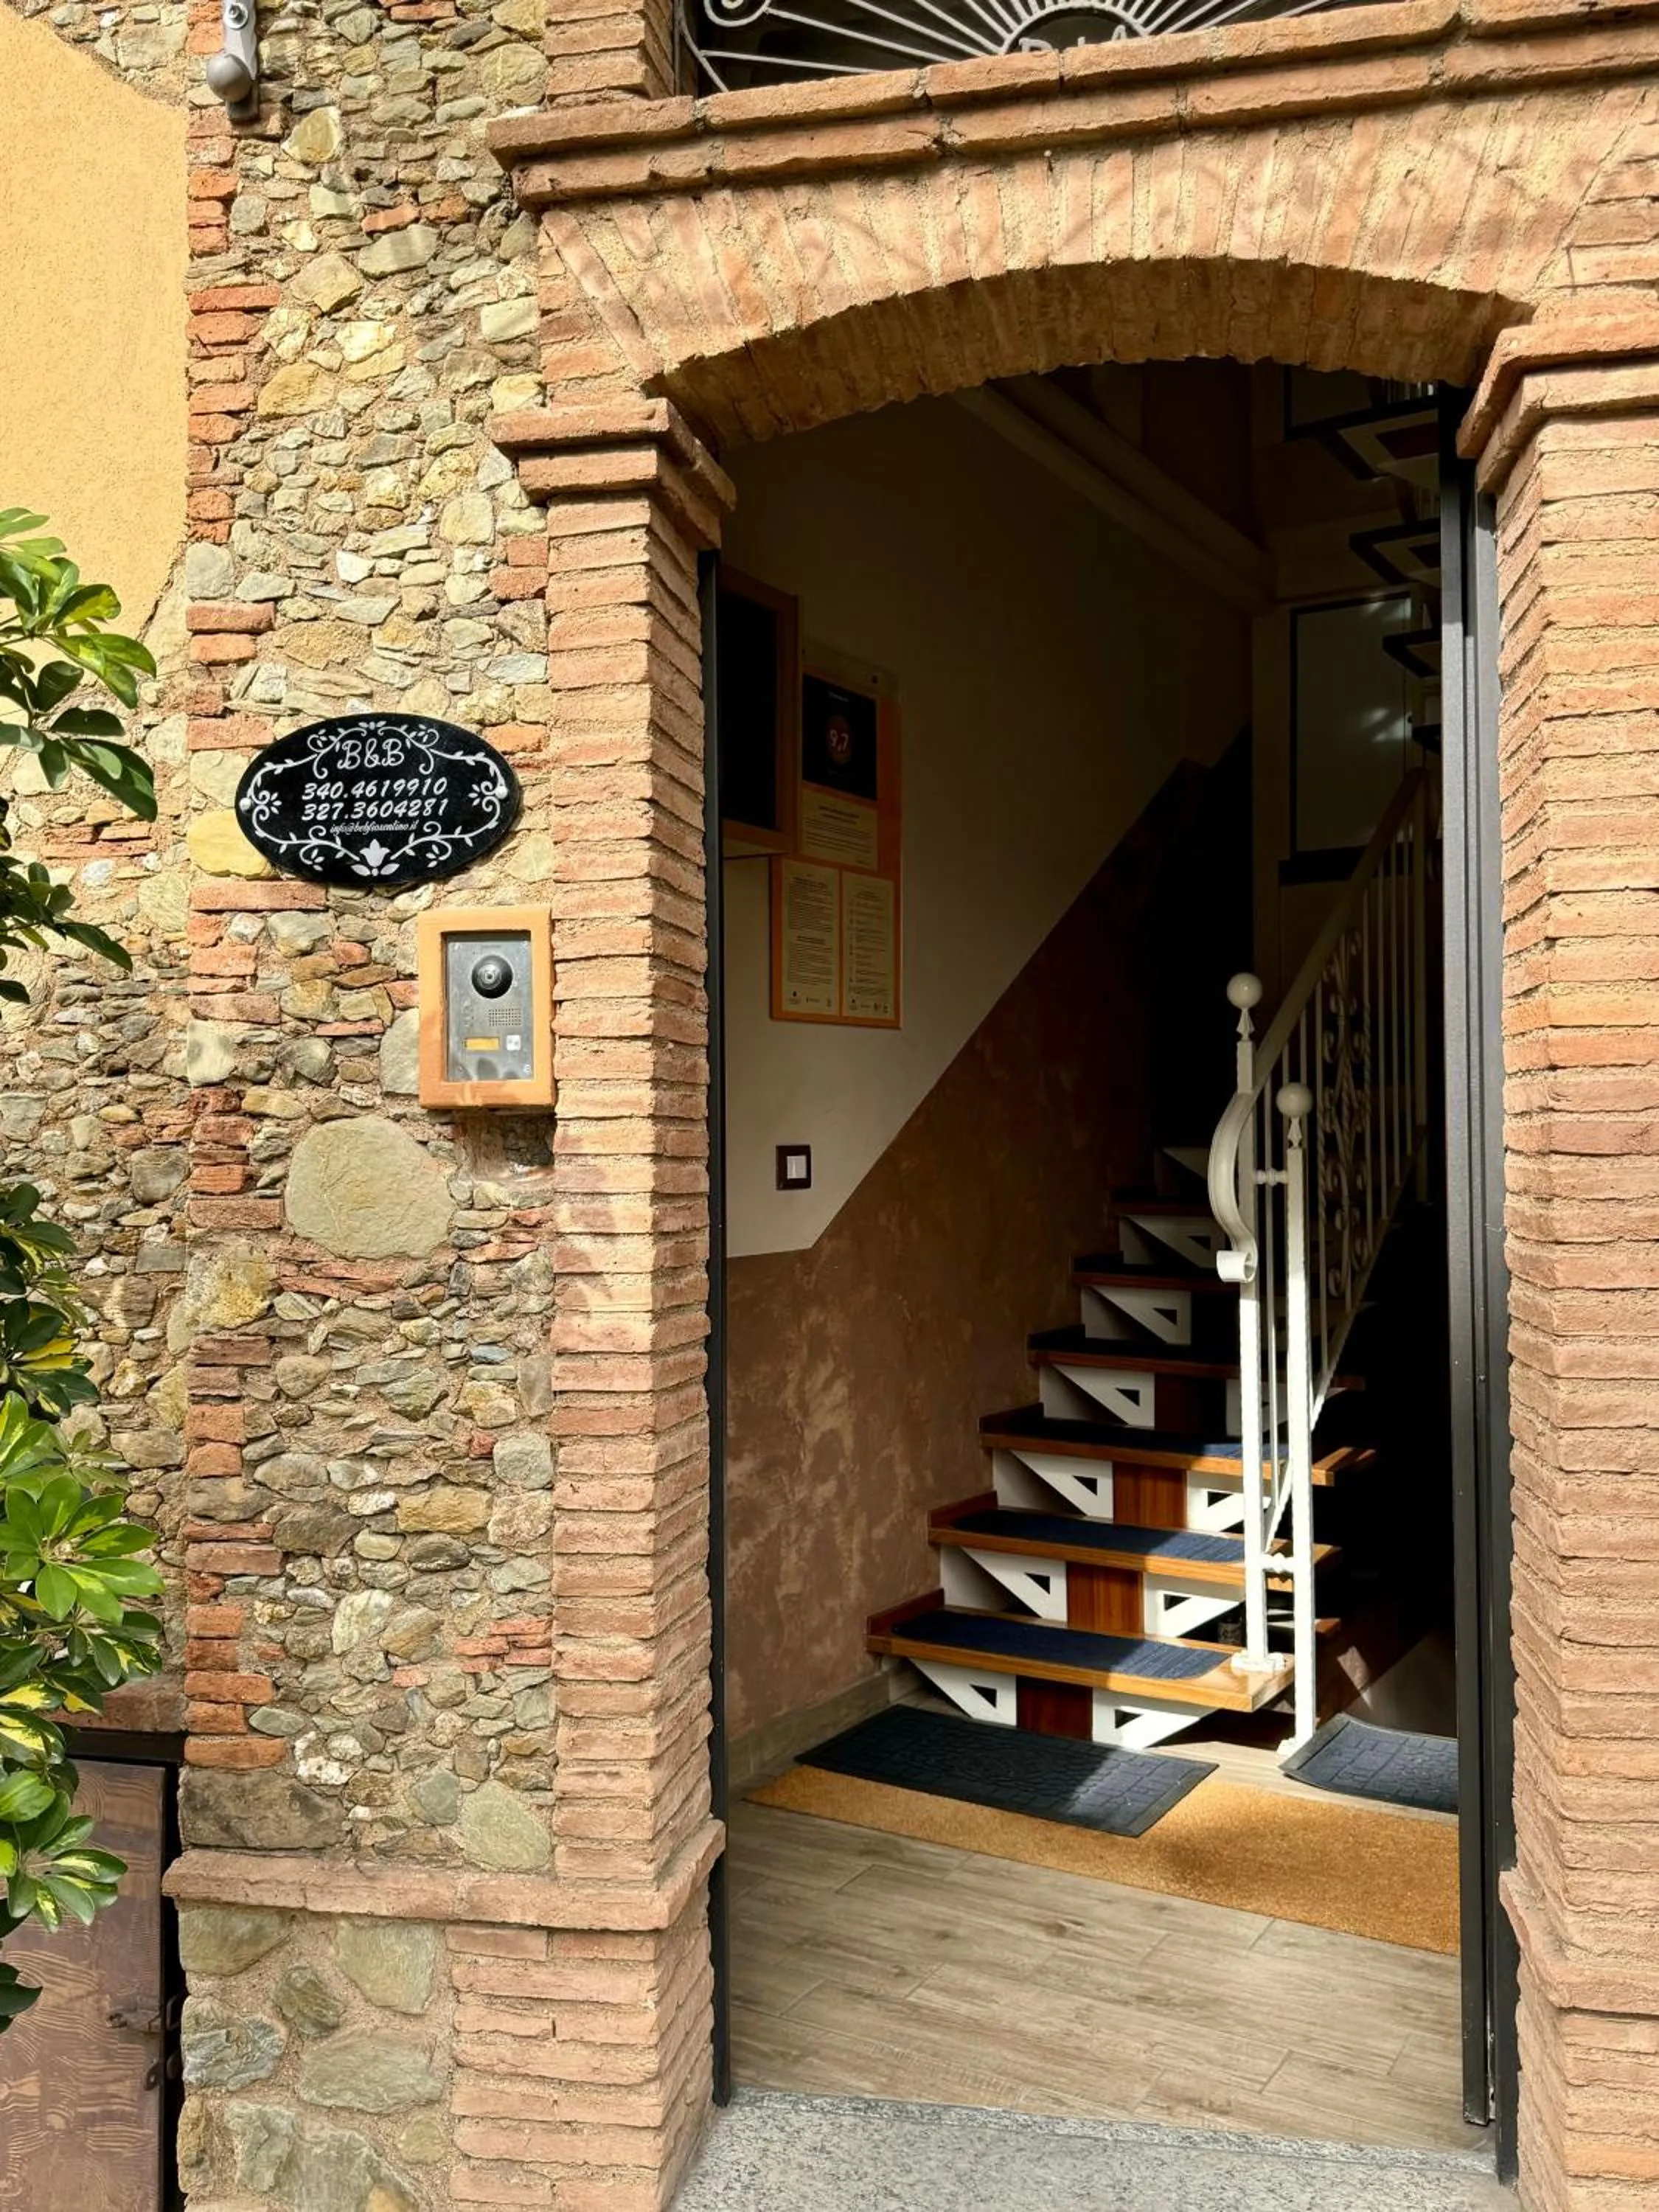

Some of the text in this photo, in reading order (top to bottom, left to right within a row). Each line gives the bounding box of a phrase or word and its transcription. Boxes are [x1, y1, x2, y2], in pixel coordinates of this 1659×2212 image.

[337, 738, 405, 770] B&B
[302, 776, 448, 800] 340.4619910
[302, 798, 448, 821] 327.3604281
